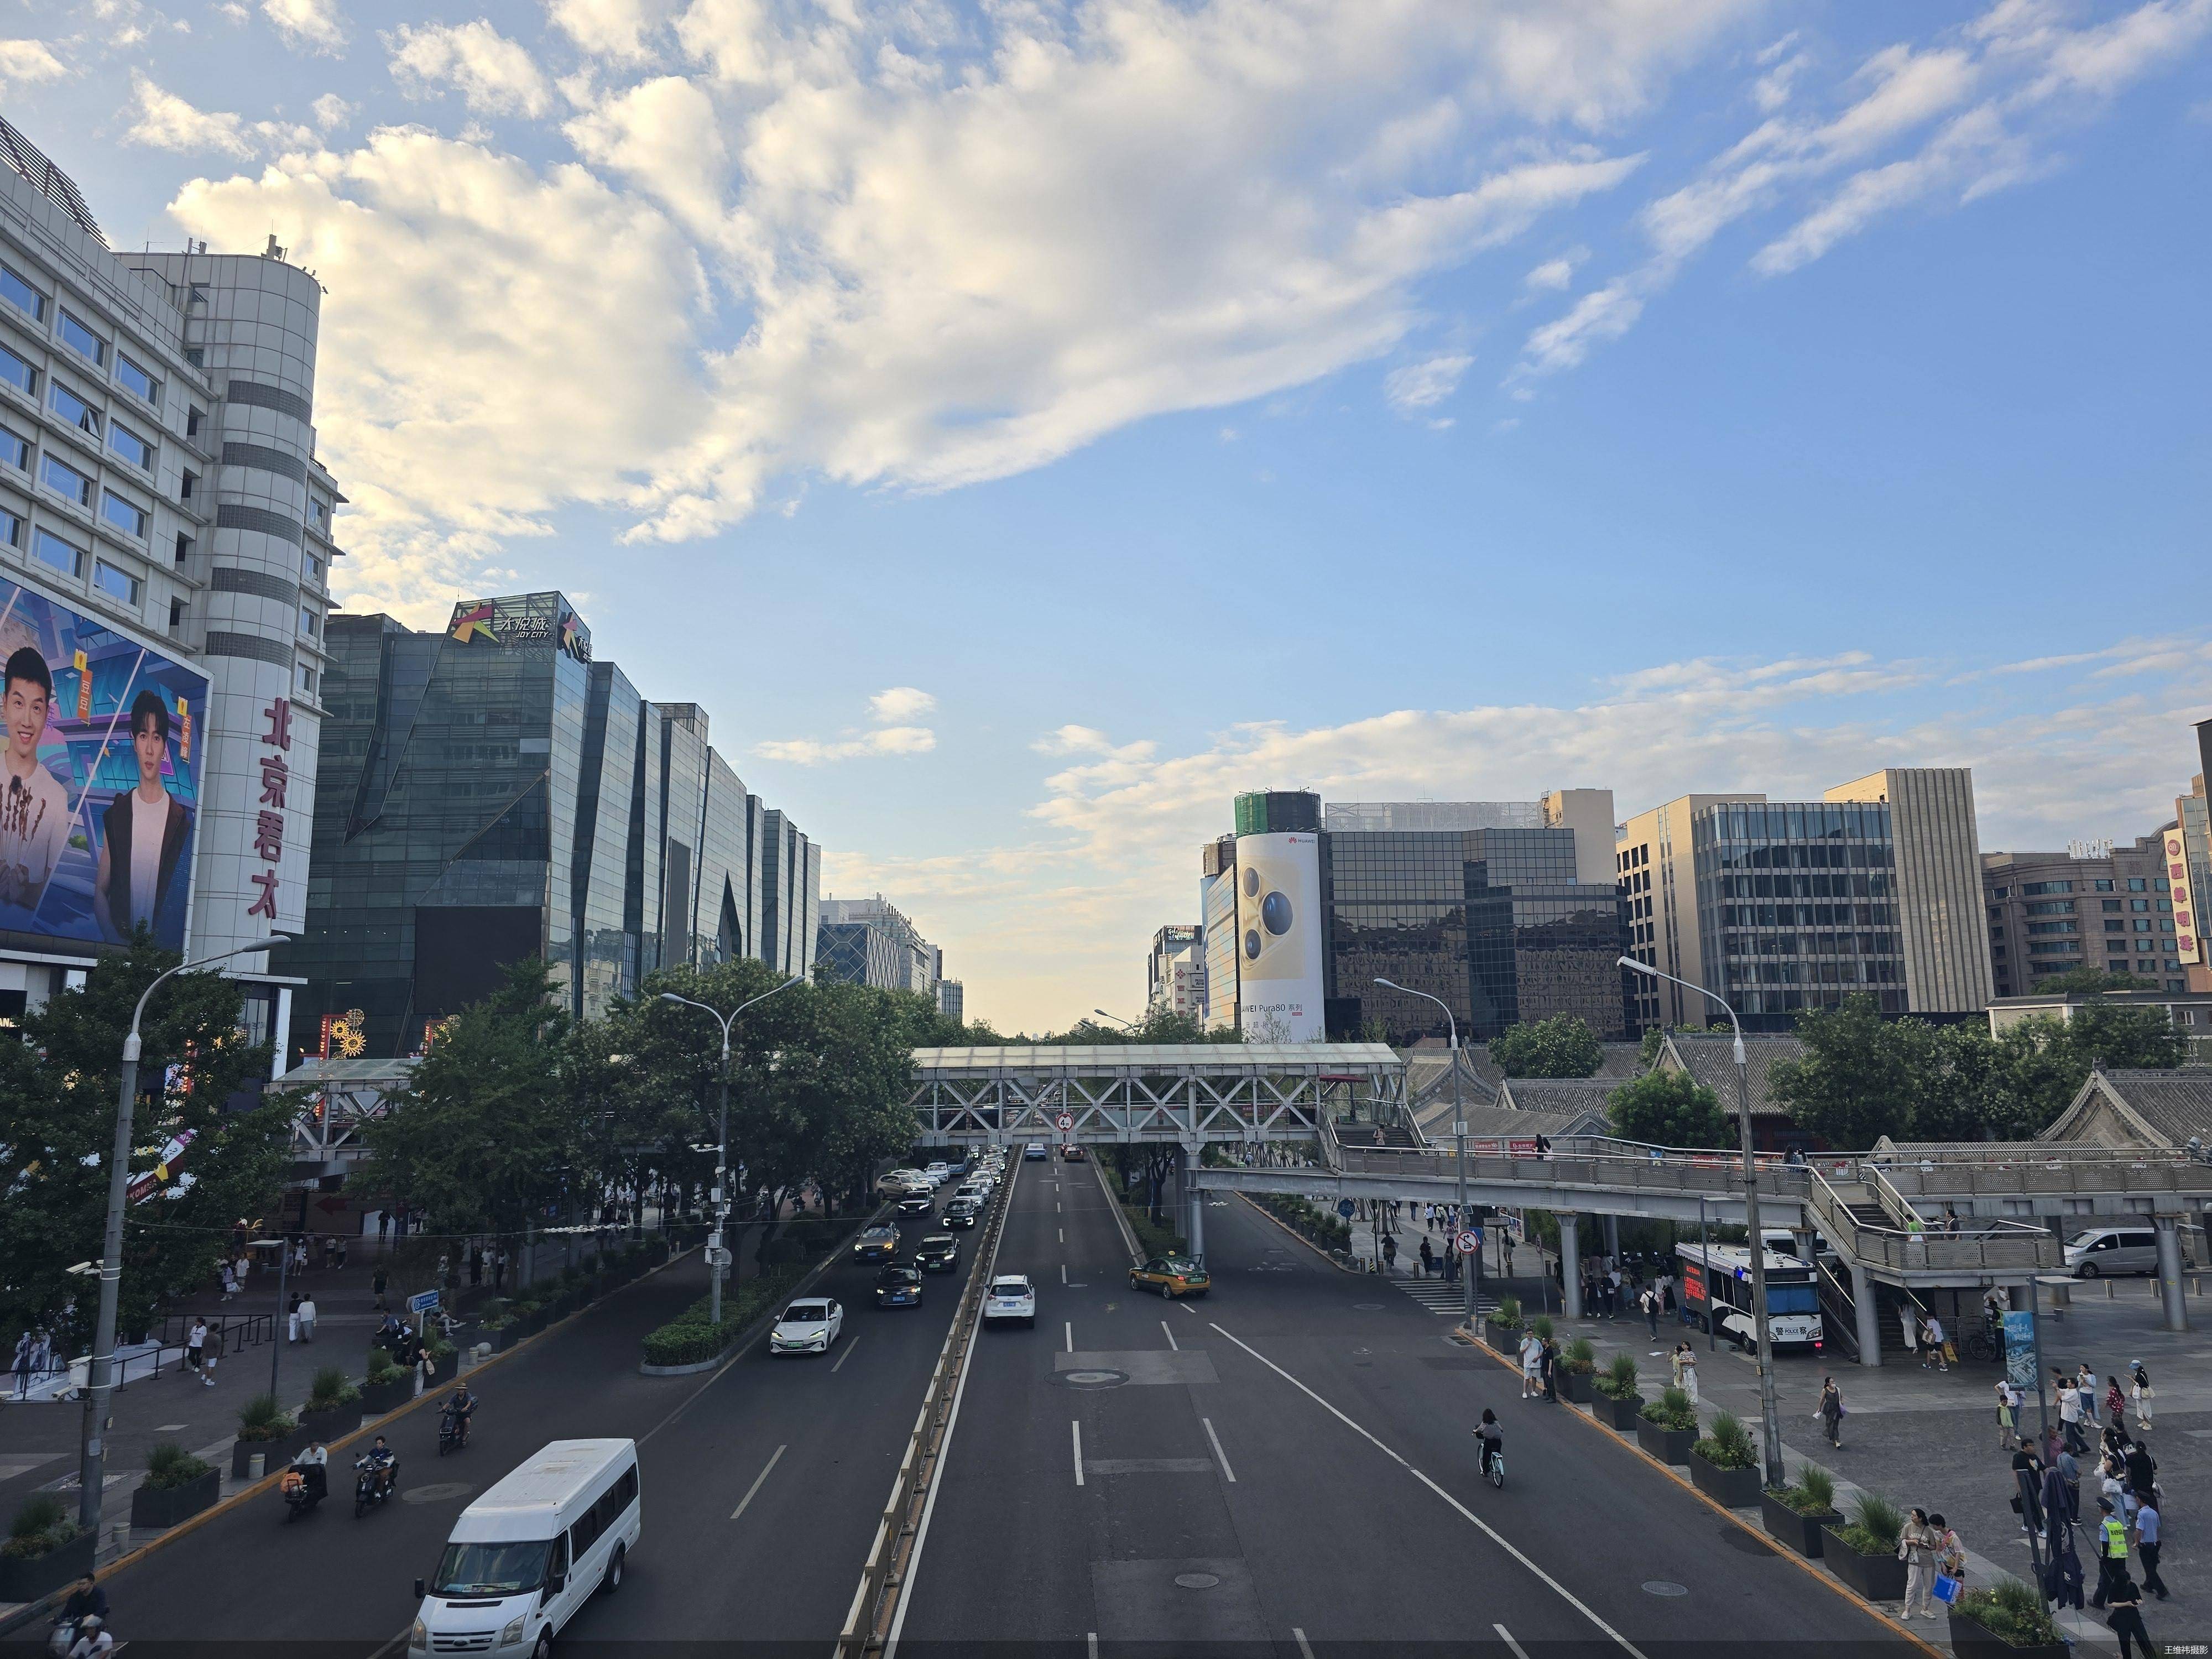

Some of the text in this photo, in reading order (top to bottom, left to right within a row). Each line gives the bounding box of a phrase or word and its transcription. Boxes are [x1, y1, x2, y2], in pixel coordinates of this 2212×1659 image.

[500, 617, 547, 631] 大悦城
[80, 680, 90, 711] 豆豆
[248, 697, 292, 919] 北京君太
